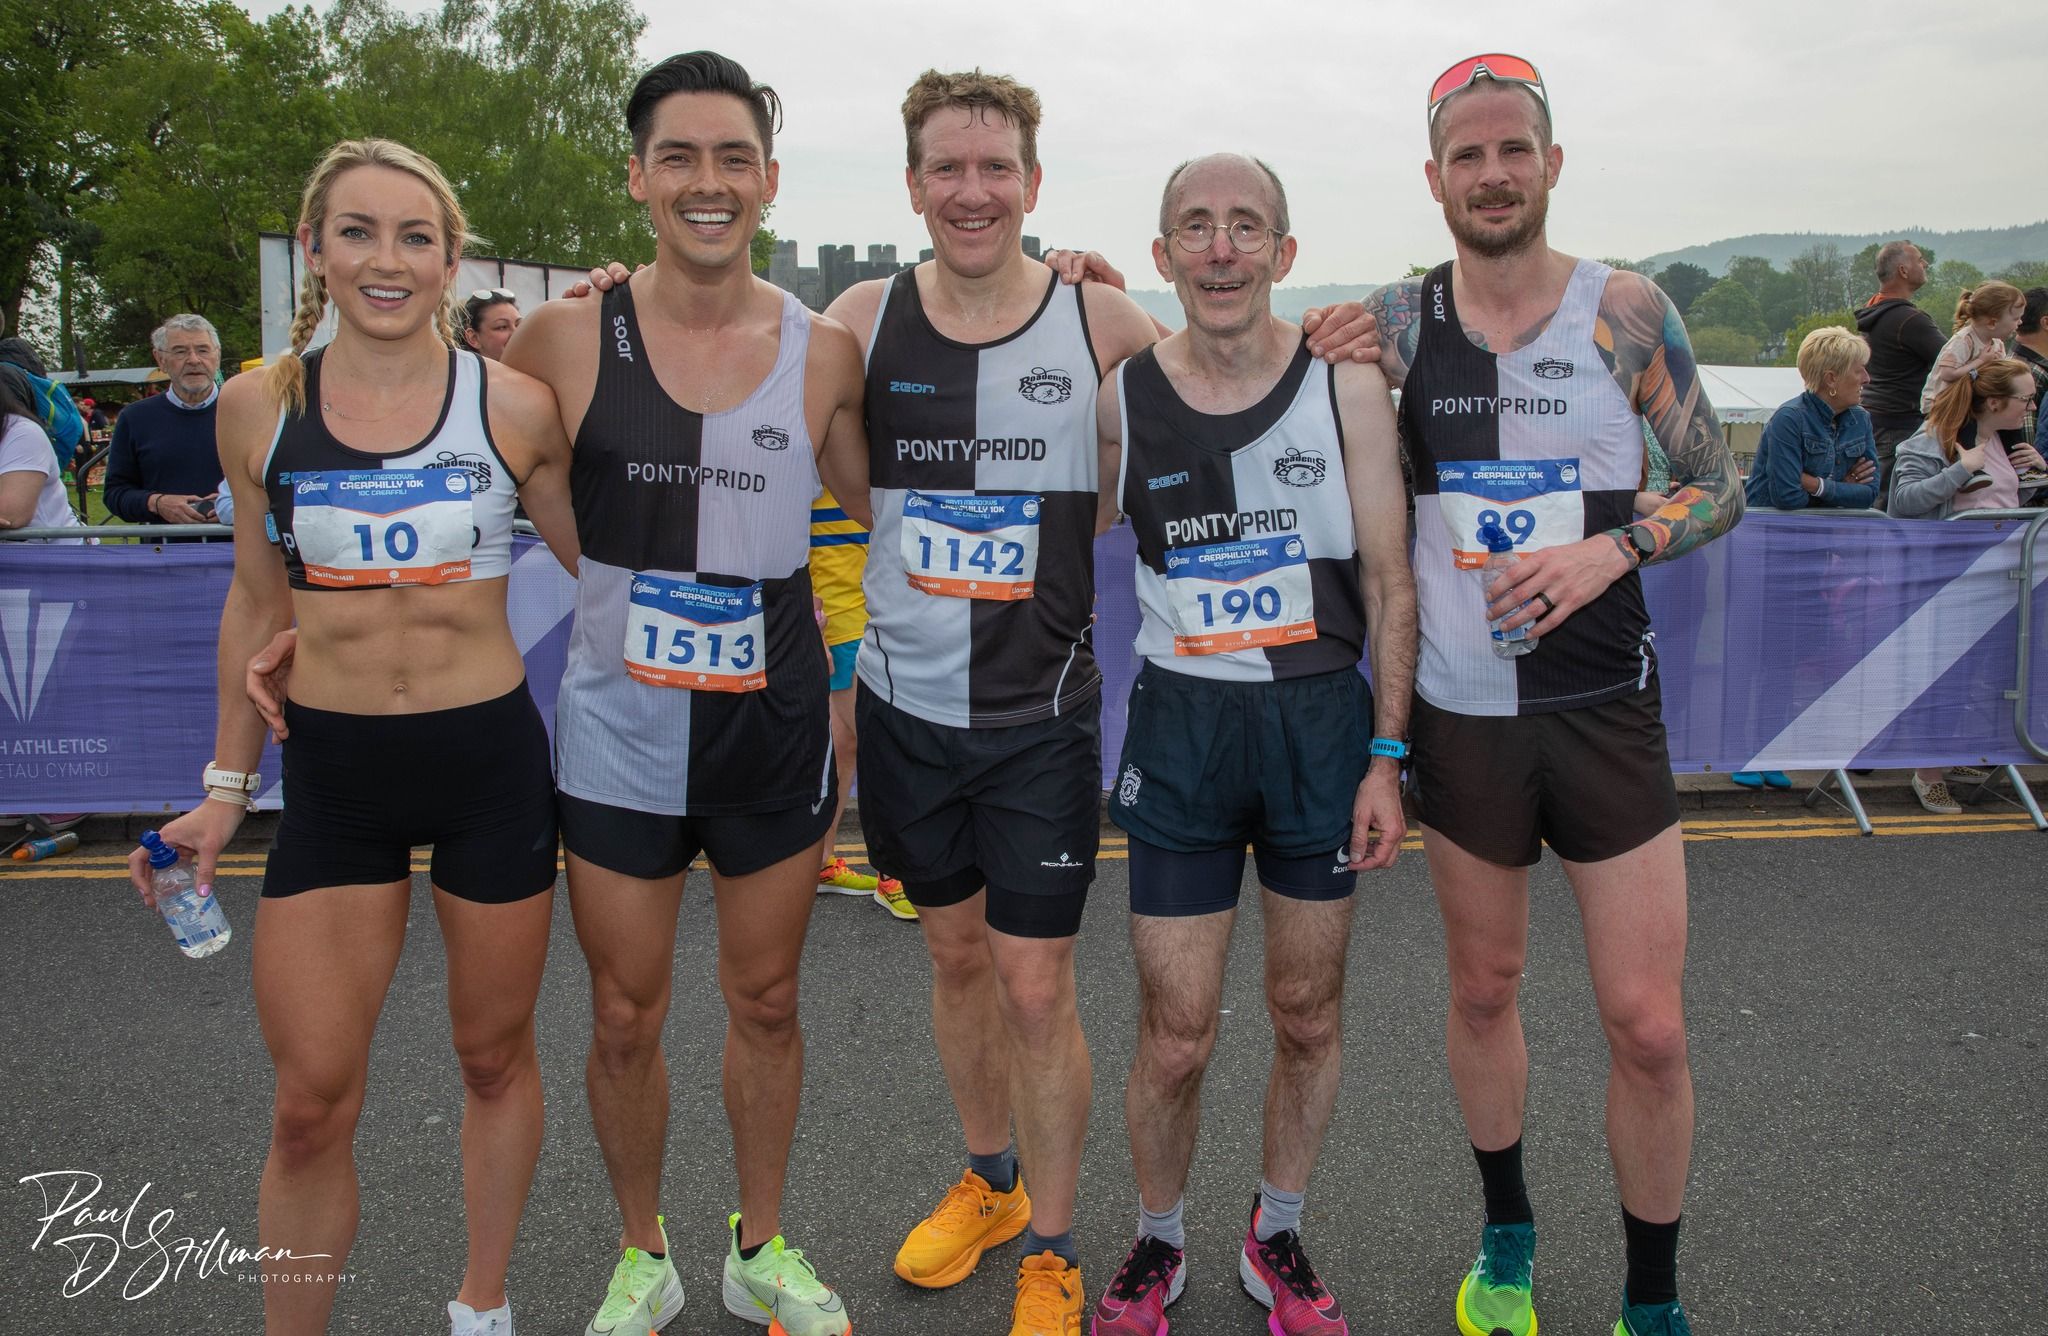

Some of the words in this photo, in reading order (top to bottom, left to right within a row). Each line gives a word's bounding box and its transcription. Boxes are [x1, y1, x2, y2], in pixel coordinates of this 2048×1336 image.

[1433, 283, 1446, 322] soar
[613, 315, 634, 363] soar
[1432, 397, 1567, 416] PONTYPRIDD
[896, 438, 1046, 461] PONTYPRIDD
[340, 480, 403, 490] CAERPHILLY
[406, 479, 424, 488] 10K
[627, 462, 765, 493] PONTYPRIDD
[1472, 471, 1526, 479] CAERPHILLY
[1528, 471, 1544, 479] 10K
[353, 521, 419, 561] 10
[1476, 509, 1536, 546] 89
[919, 535, 1025, 575] 1142
[1199, 550, 1250, 562] CAERPHILLY
[1253, 548, 1268, 557] 10K
[670, 590, 726, 605] CAERPHILLY
[727, 598, 743, 606] 10K
[1197, 586, 1281, 627] 190
[643, 624, 755, 670] 1513
[13, 738, 108, 755] ATHLETICS
[46, 762, 109, 778] CYMRU
